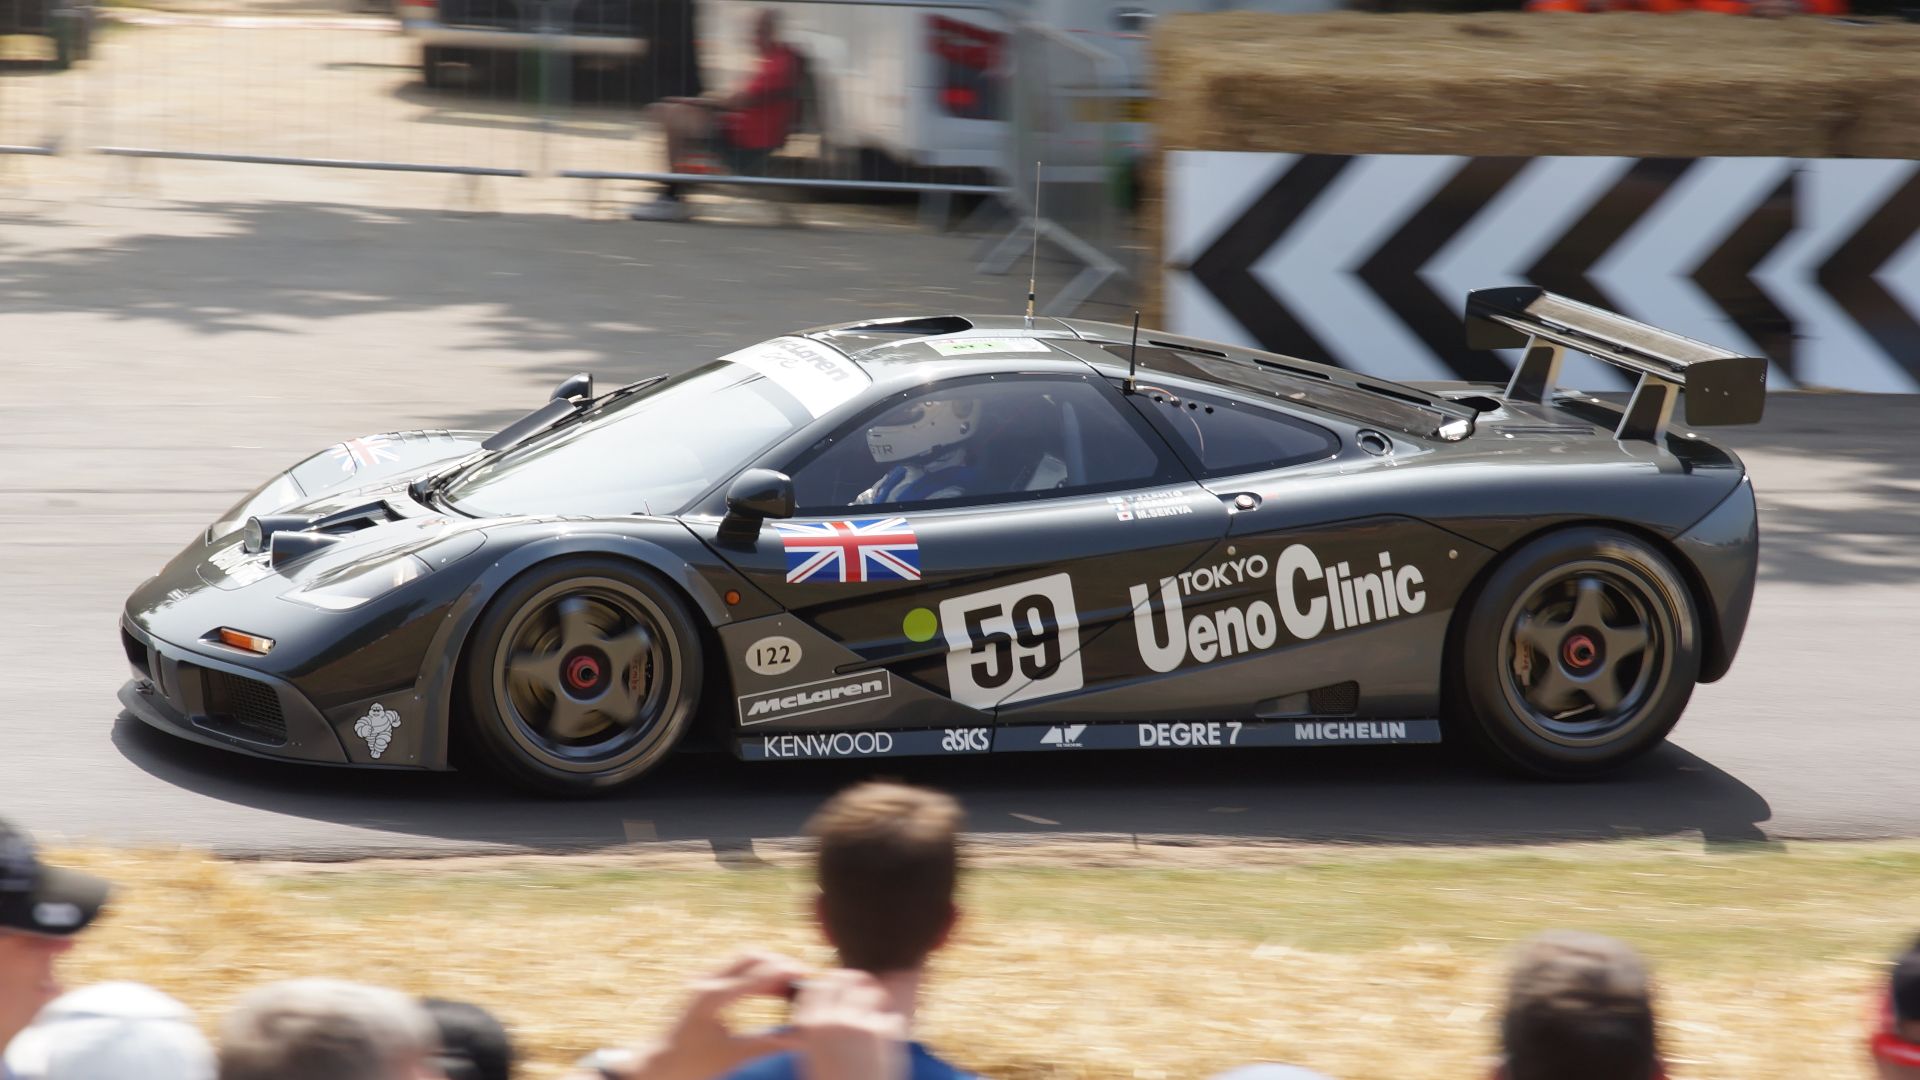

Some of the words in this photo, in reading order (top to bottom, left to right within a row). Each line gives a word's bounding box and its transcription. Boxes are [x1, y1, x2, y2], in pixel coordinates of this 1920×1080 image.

[1135, 504, 1193, 519] M.SEKIYA
[1178, 554, 1269, 596] TOKYO
[1129, 575, 1278, 673] Ueno
[1275, 543, 1427, 640] Clinic
[963, 593, 1062, 689] 59
[756, 645, 791, 667] 122
[746, 679, 884, 717] McLaren
[1138, 722, 1222, 747] DEGRE
[1226, 722, 1243, 745] 7
[1295, 722, 1407, 740] MICHELIN
[764, 732, 893, 757] KENWOOD
